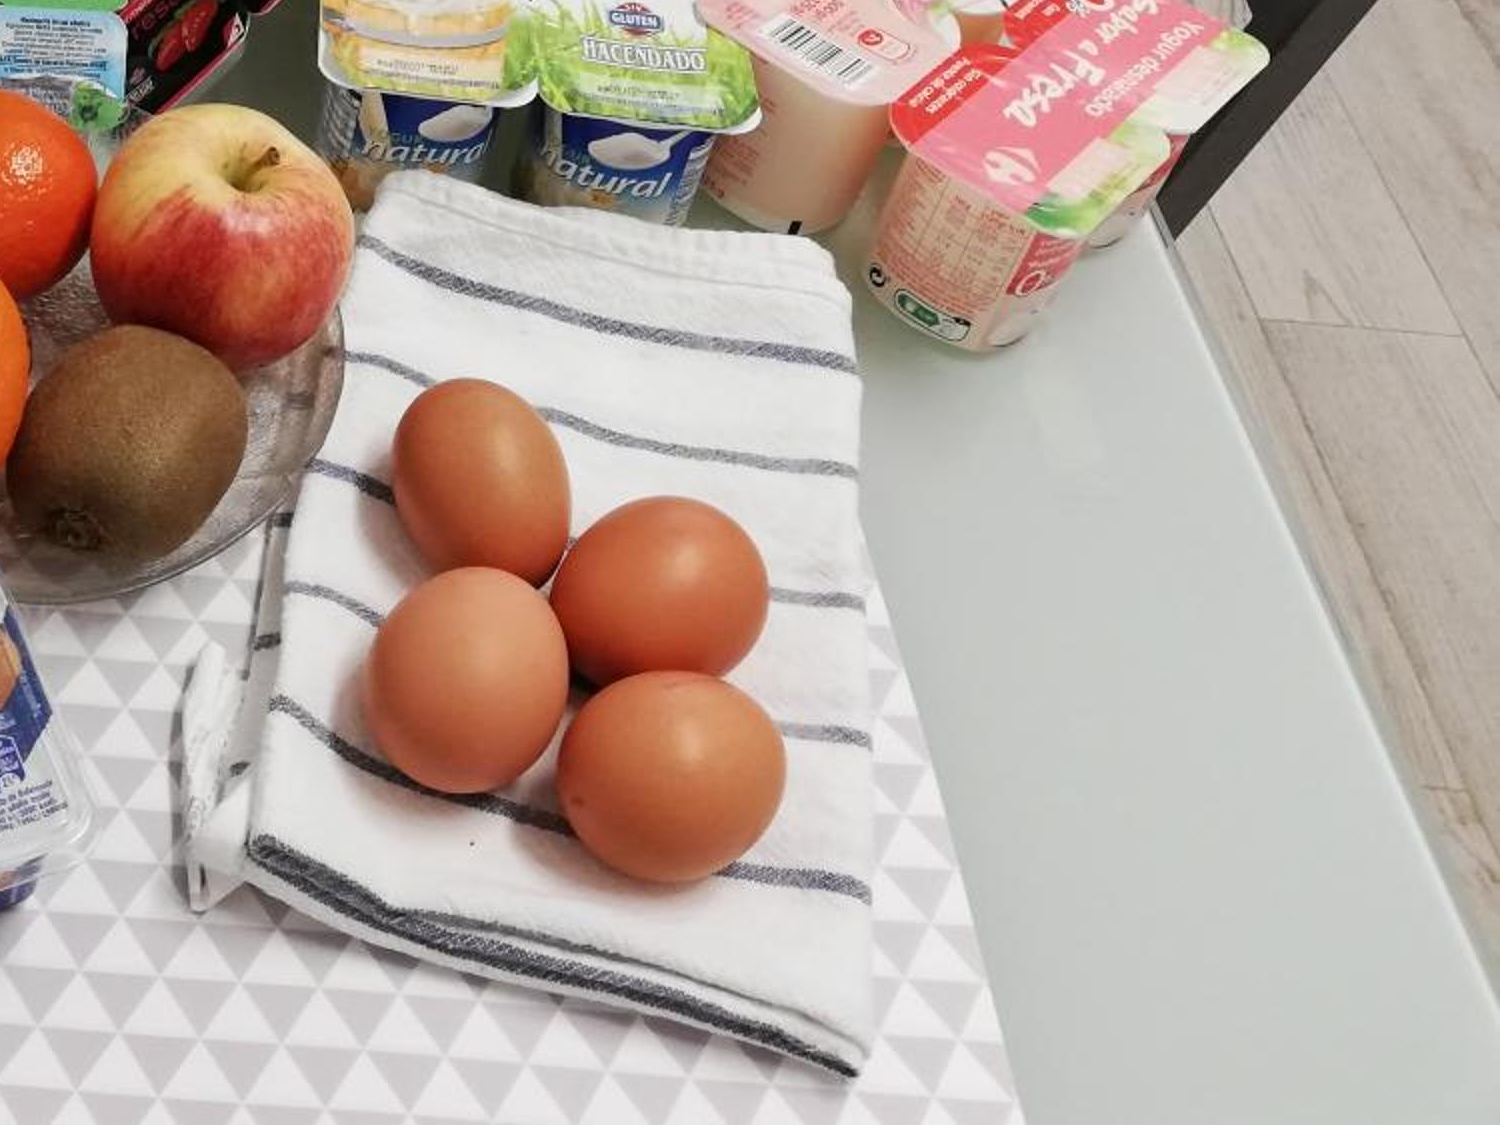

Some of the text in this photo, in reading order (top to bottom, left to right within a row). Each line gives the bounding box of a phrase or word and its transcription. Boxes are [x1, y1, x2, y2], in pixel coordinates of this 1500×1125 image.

[611, 13, 660, 29] GLUTEN
[582, 36, 708, 73] HACENDADO
[1078, 38, 1100, 56] a
[1003, 49, 1107, 128] Fresa
[1084, 20, 1206, 118] Yogur desnatado
[547, 150, 673, 199] natural
